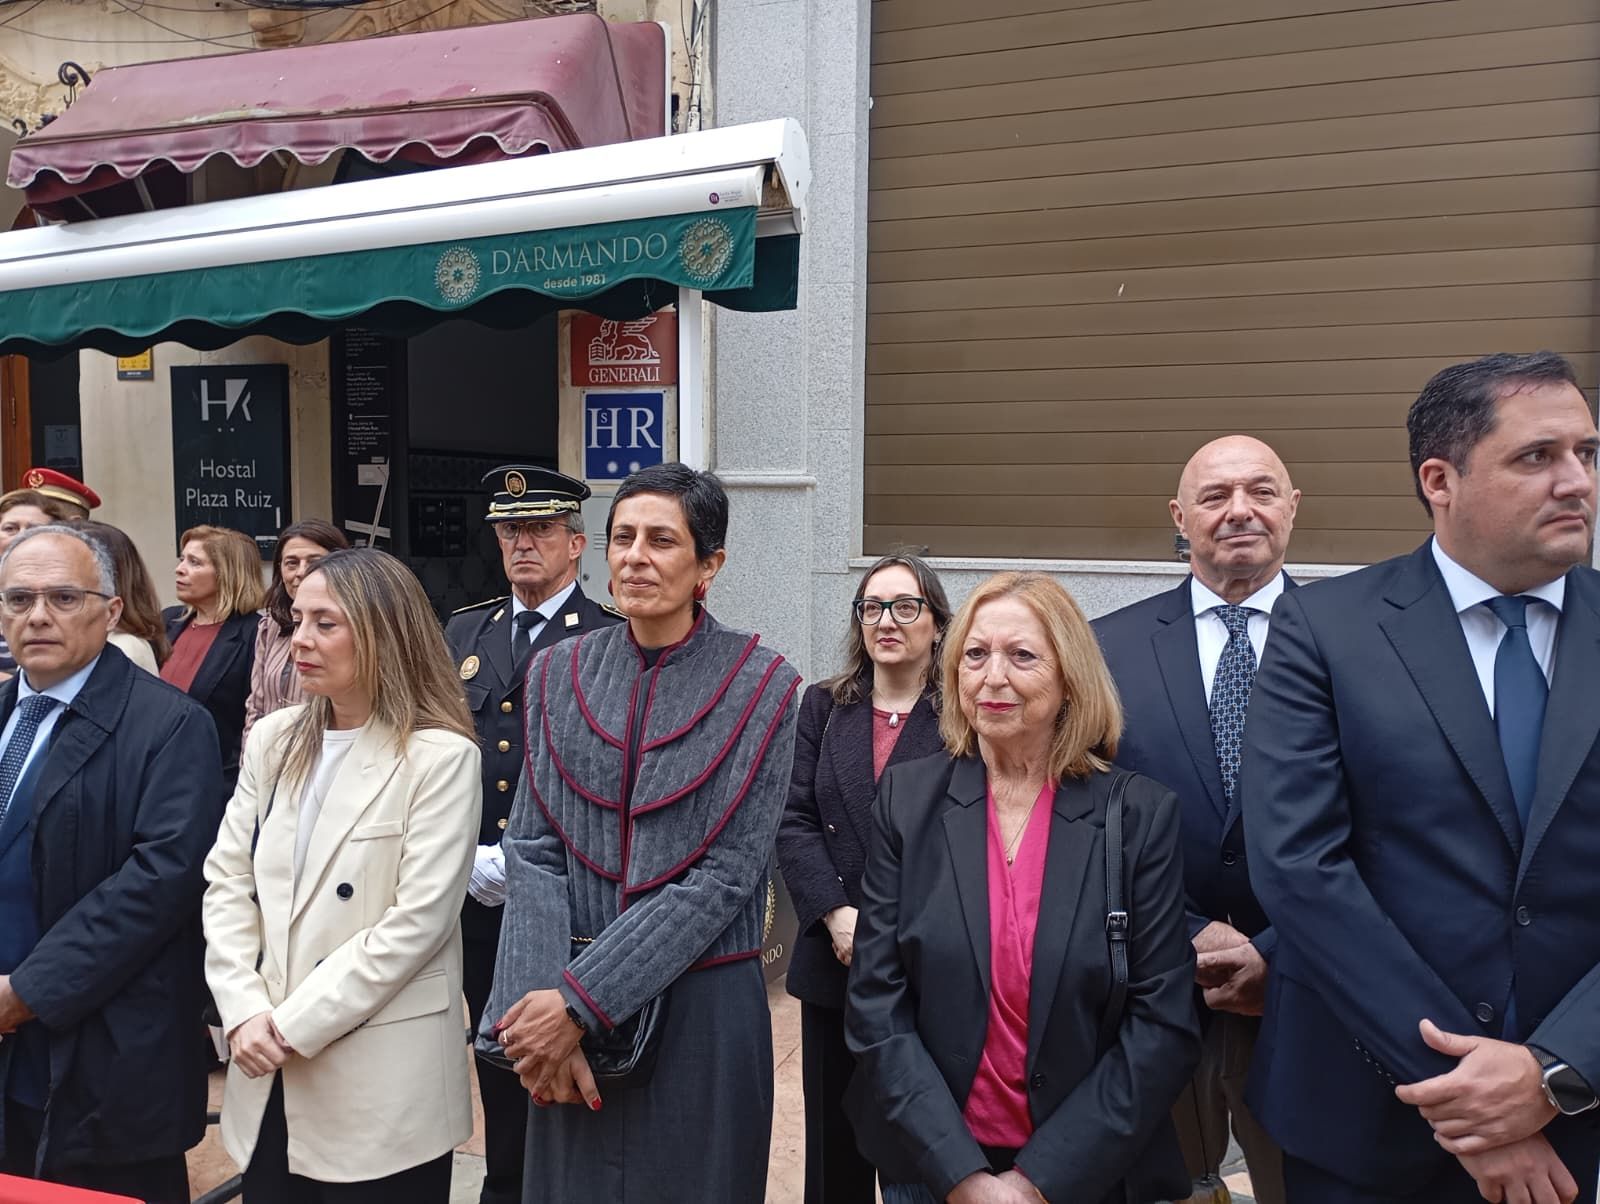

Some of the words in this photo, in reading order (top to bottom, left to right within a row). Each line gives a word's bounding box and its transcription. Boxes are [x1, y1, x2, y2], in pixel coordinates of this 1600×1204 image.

[491, 232, 668, 275] D'ARMANDO
[543, 276, 578, 290] desde
[579, 274, 607, 287] 1981
[588, 366, 661, 384] GENERALI
[200, 458, 257, 479] Hostal
[186, 487, 229, 508] Plaza
[235, 488, 273, 508] Ruiz
[761, 943, 783, 968] NDO
